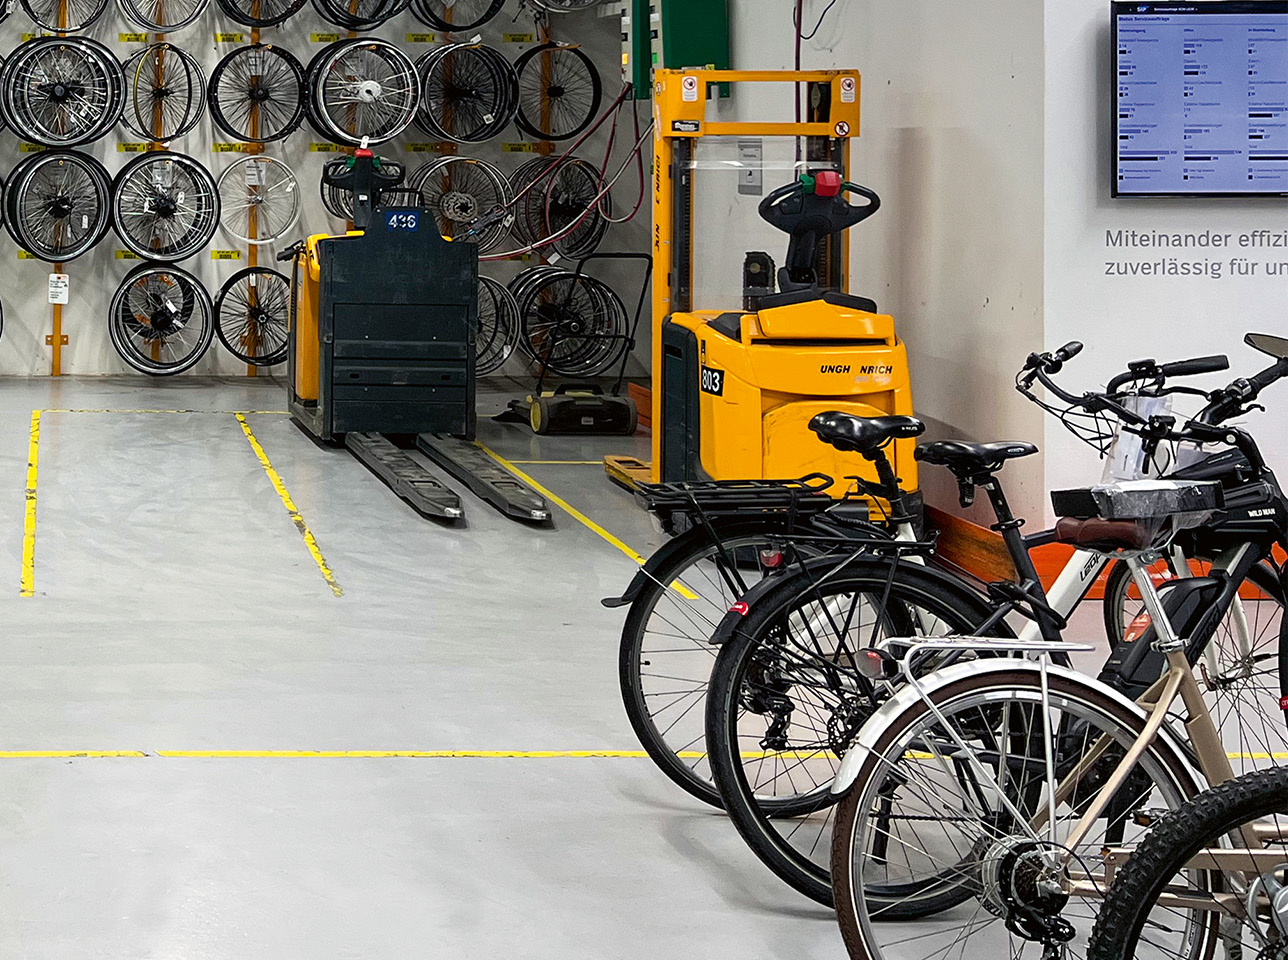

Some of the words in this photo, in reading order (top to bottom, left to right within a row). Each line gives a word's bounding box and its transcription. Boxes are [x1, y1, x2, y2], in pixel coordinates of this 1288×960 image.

[388, 214, 416, 228] 436
[1105, 230, 1231, 247] Miteinander
[1238, 230, 1288, 247] effizi
[1104, 258, 1222, 279] zuverlässig
[1229, 258, 1258, 275] für
[702, 369, 720, 392] 803
